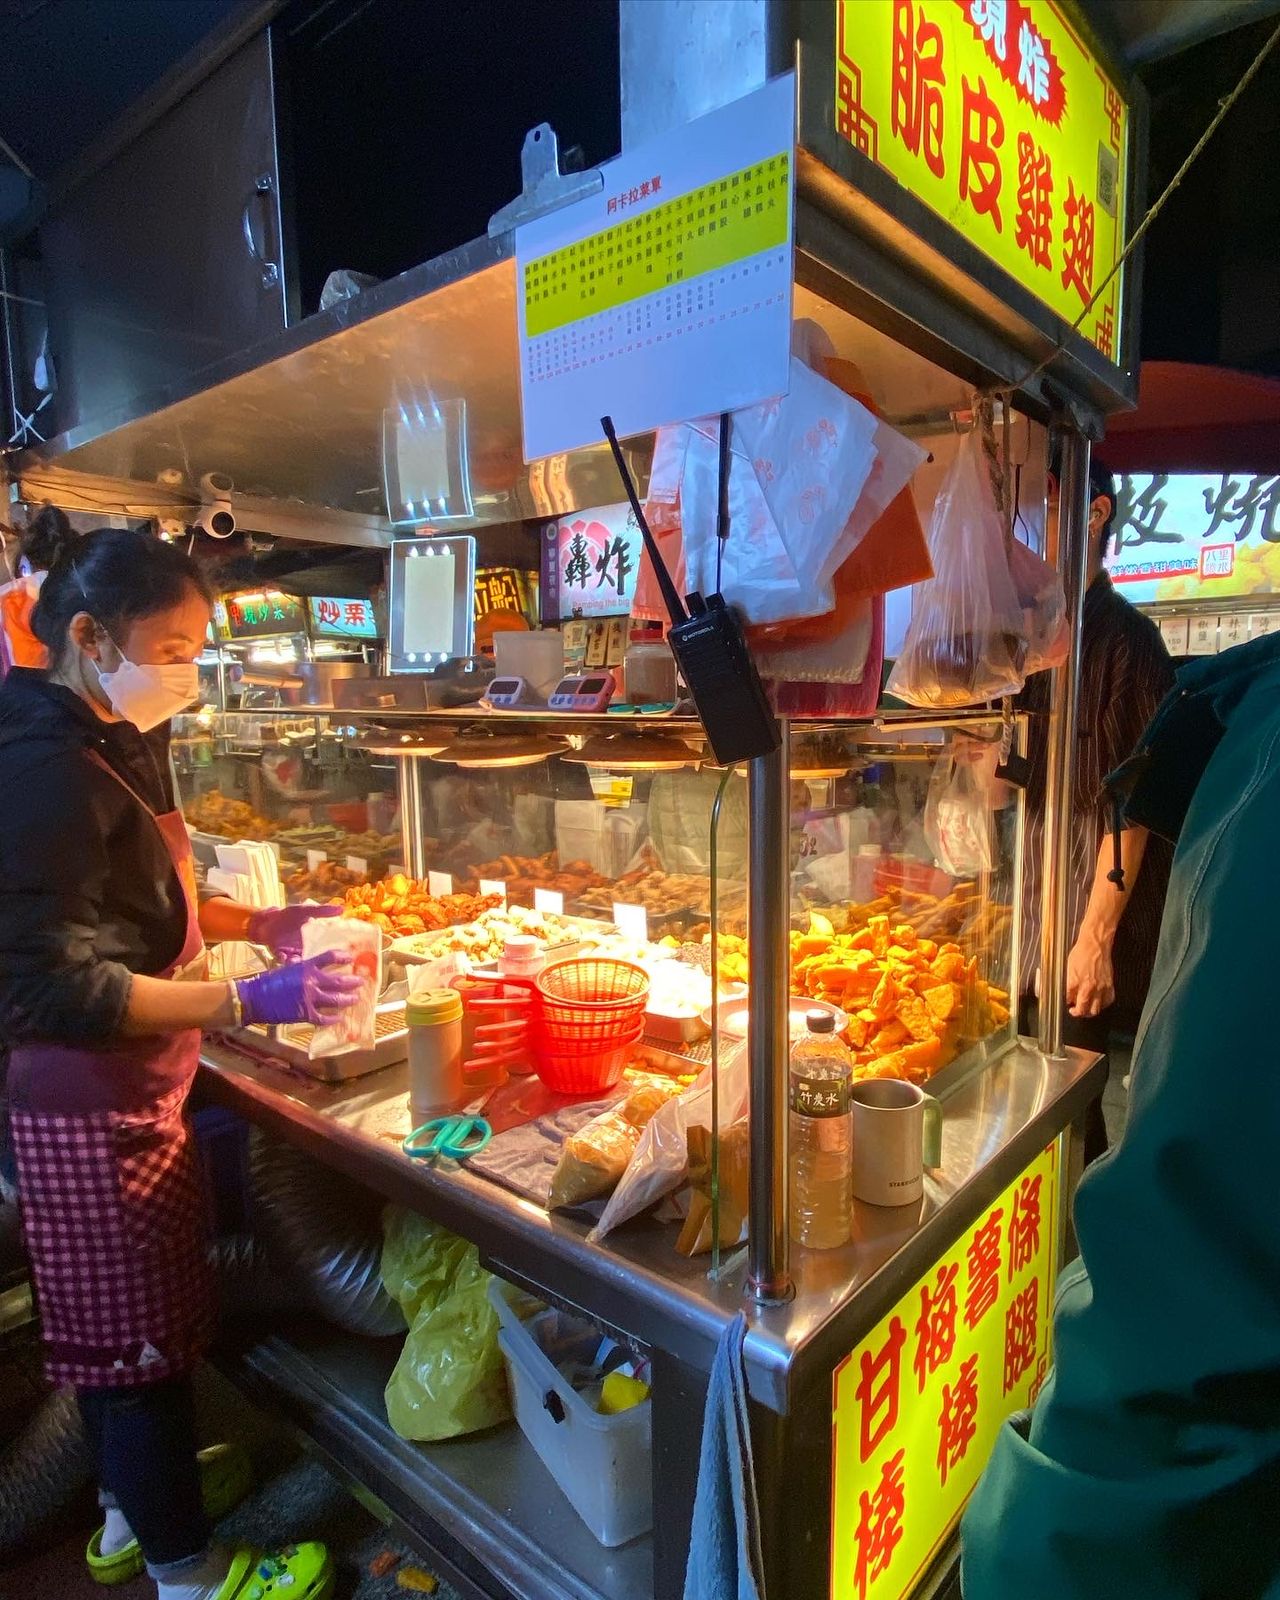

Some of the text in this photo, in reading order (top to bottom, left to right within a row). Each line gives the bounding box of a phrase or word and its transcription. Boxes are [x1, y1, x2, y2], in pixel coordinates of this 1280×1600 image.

[891, 0, 1095, 314] 脆皮雞翅
[318, 600, 376, 627] 炒栗
[853, 1276, 1040, 1600] 棒棒腿
[854, 1173, 1044, 1465] 甘梅薯條
